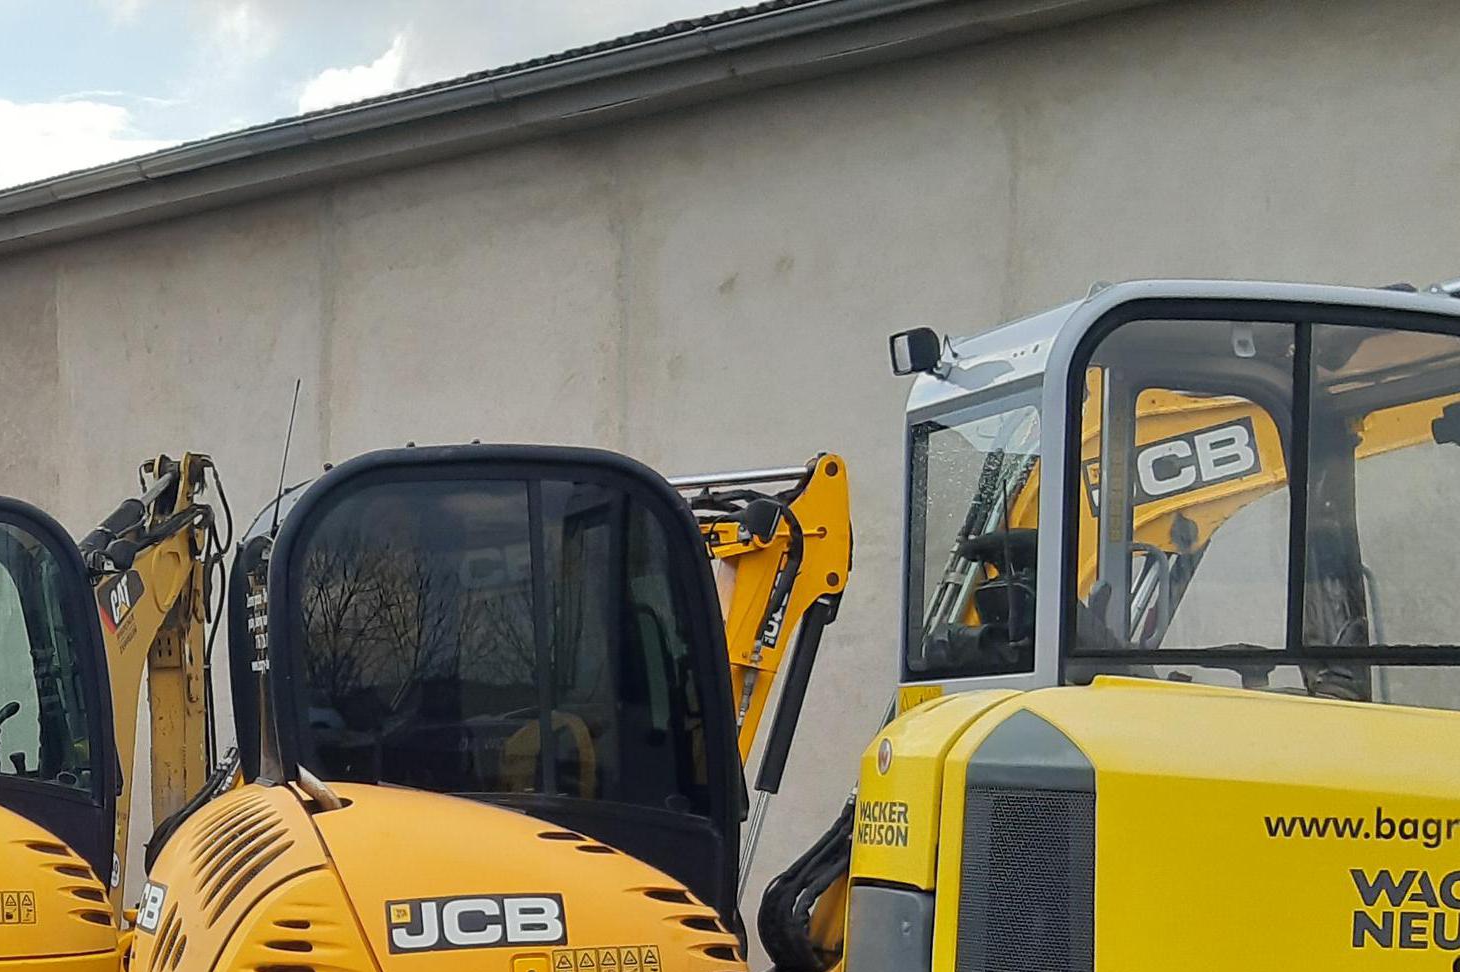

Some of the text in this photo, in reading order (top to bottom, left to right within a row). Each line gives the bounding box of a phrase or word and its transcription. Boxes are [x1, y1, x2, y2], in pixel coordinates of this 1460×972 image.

[1092, 424, 1255, 508] CB
[110, 573, 131, 625] CAT
[857, 823, 908, 847] NEUSON
[859, 801, 908, 824] WACKER
[1263, 806, 1460, 849] www.bagr
[392, 897, 563, 949] JCB
